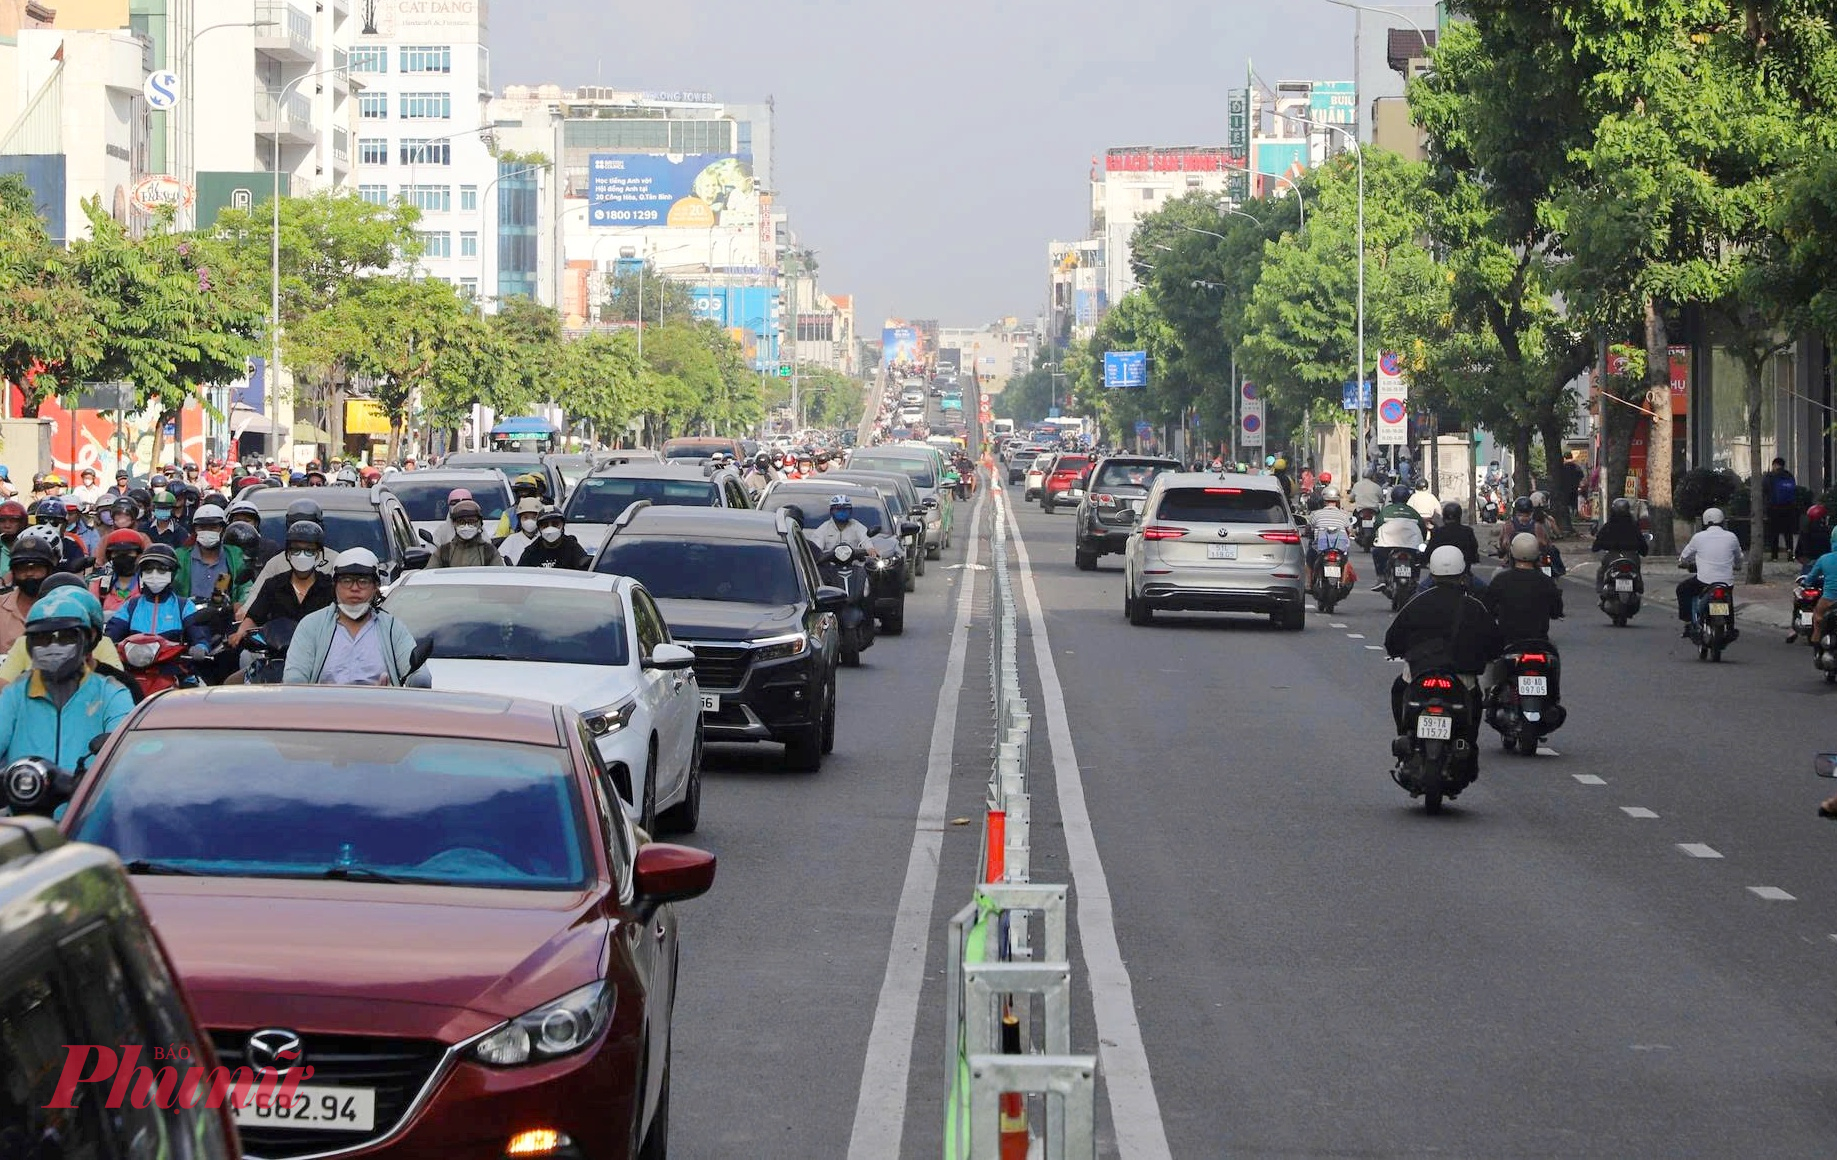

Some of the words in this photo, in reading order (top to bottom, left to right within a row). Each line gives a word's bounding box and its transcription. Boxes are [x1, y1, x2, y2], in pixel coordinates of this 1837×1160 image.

[682, 91, 714, 102] TOWER
[605, 210, 630, 220] 1800
[633, 210, 658, 220] 1299
